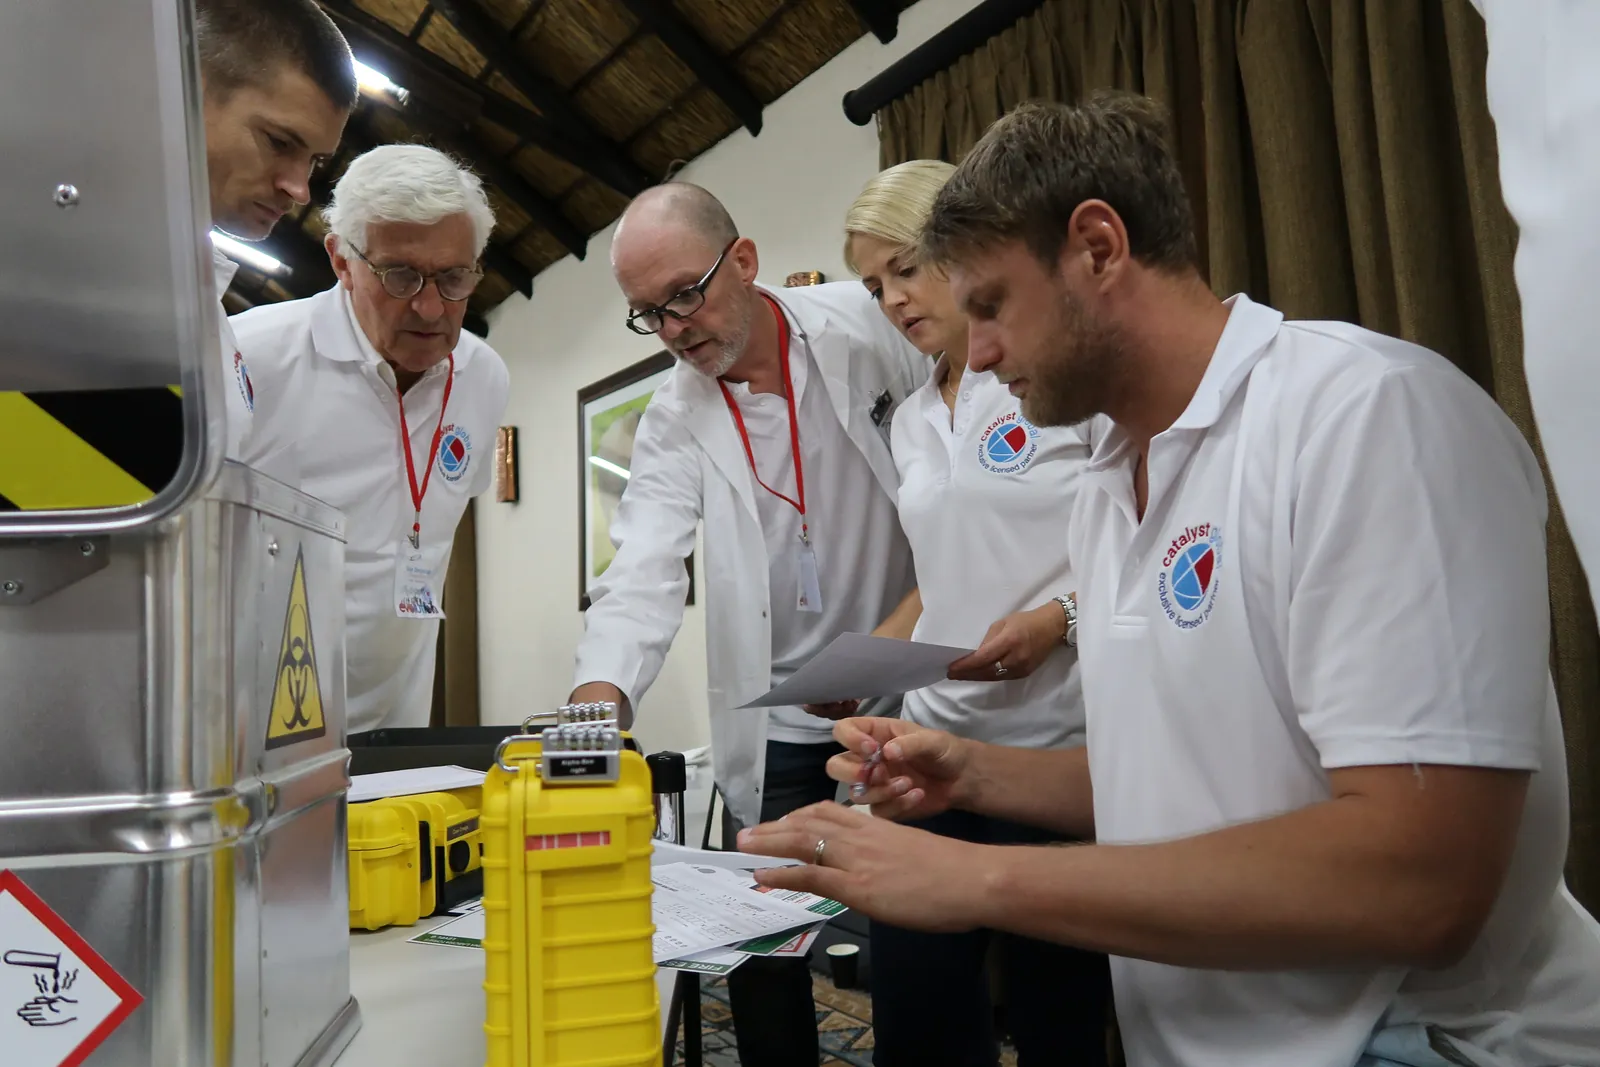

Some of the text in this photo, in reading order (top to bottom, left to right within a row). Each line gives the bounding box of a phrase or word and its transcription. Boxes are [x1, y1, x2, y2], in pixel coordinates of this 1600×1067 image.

[980, 412, 1016, 442] catalyst
[1020, 444, 1037, 468] partner
[1162, 522, 1211, 567] catalyst
[1158, 572, 1175, 620] exclusive
[1175, 614, 1204, 629] licensed
[687, 962, 724, 972] FIRE
